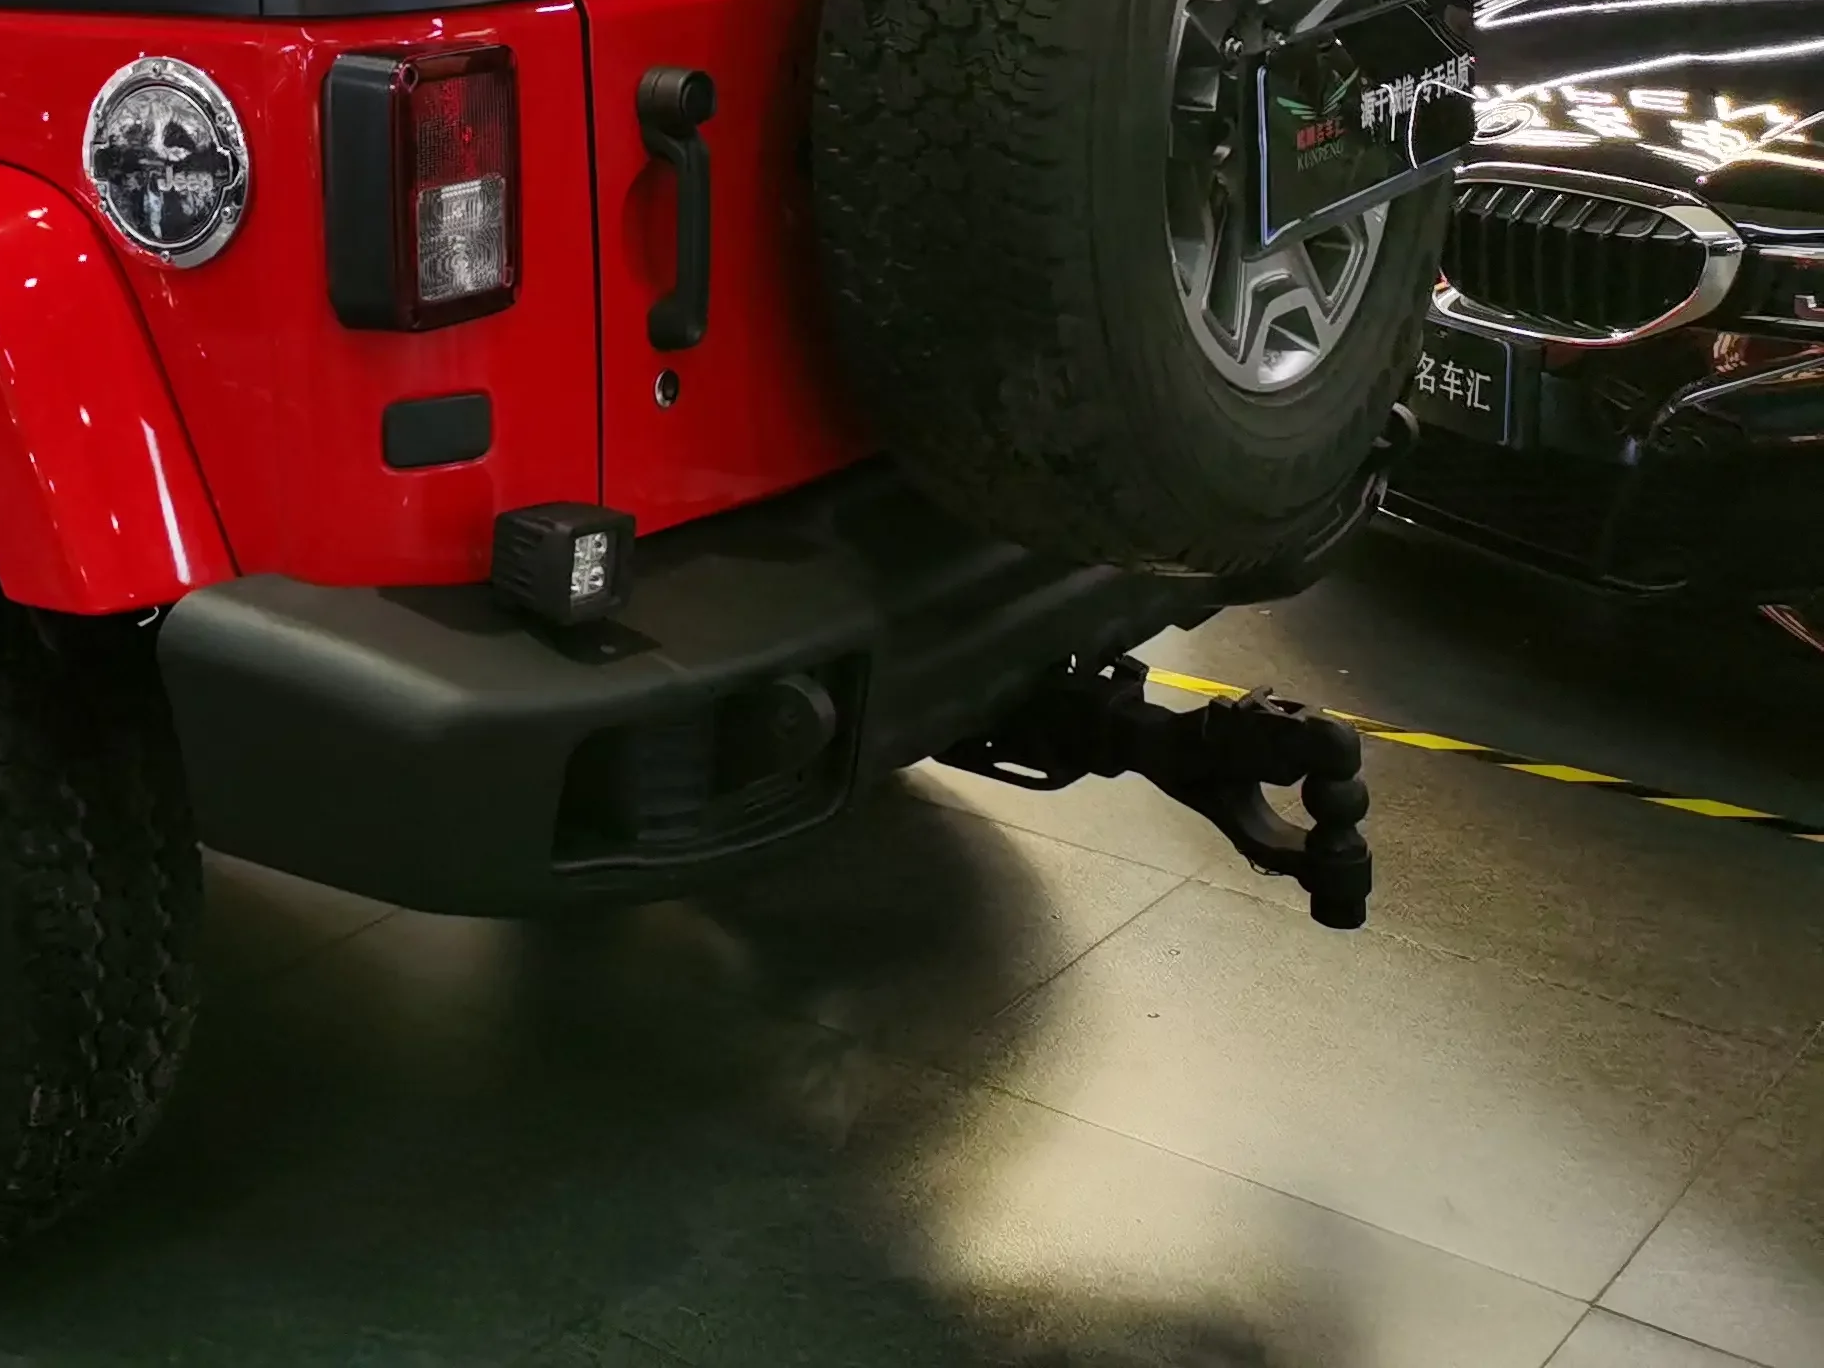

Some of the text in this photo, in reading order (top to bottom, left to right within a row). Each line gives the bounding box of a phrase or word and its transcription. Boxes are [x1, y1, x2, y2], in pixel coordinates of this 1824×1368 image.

[157, 165, 214, 192] Jeep
[1415, 352, 1492, 412] 名车汇
